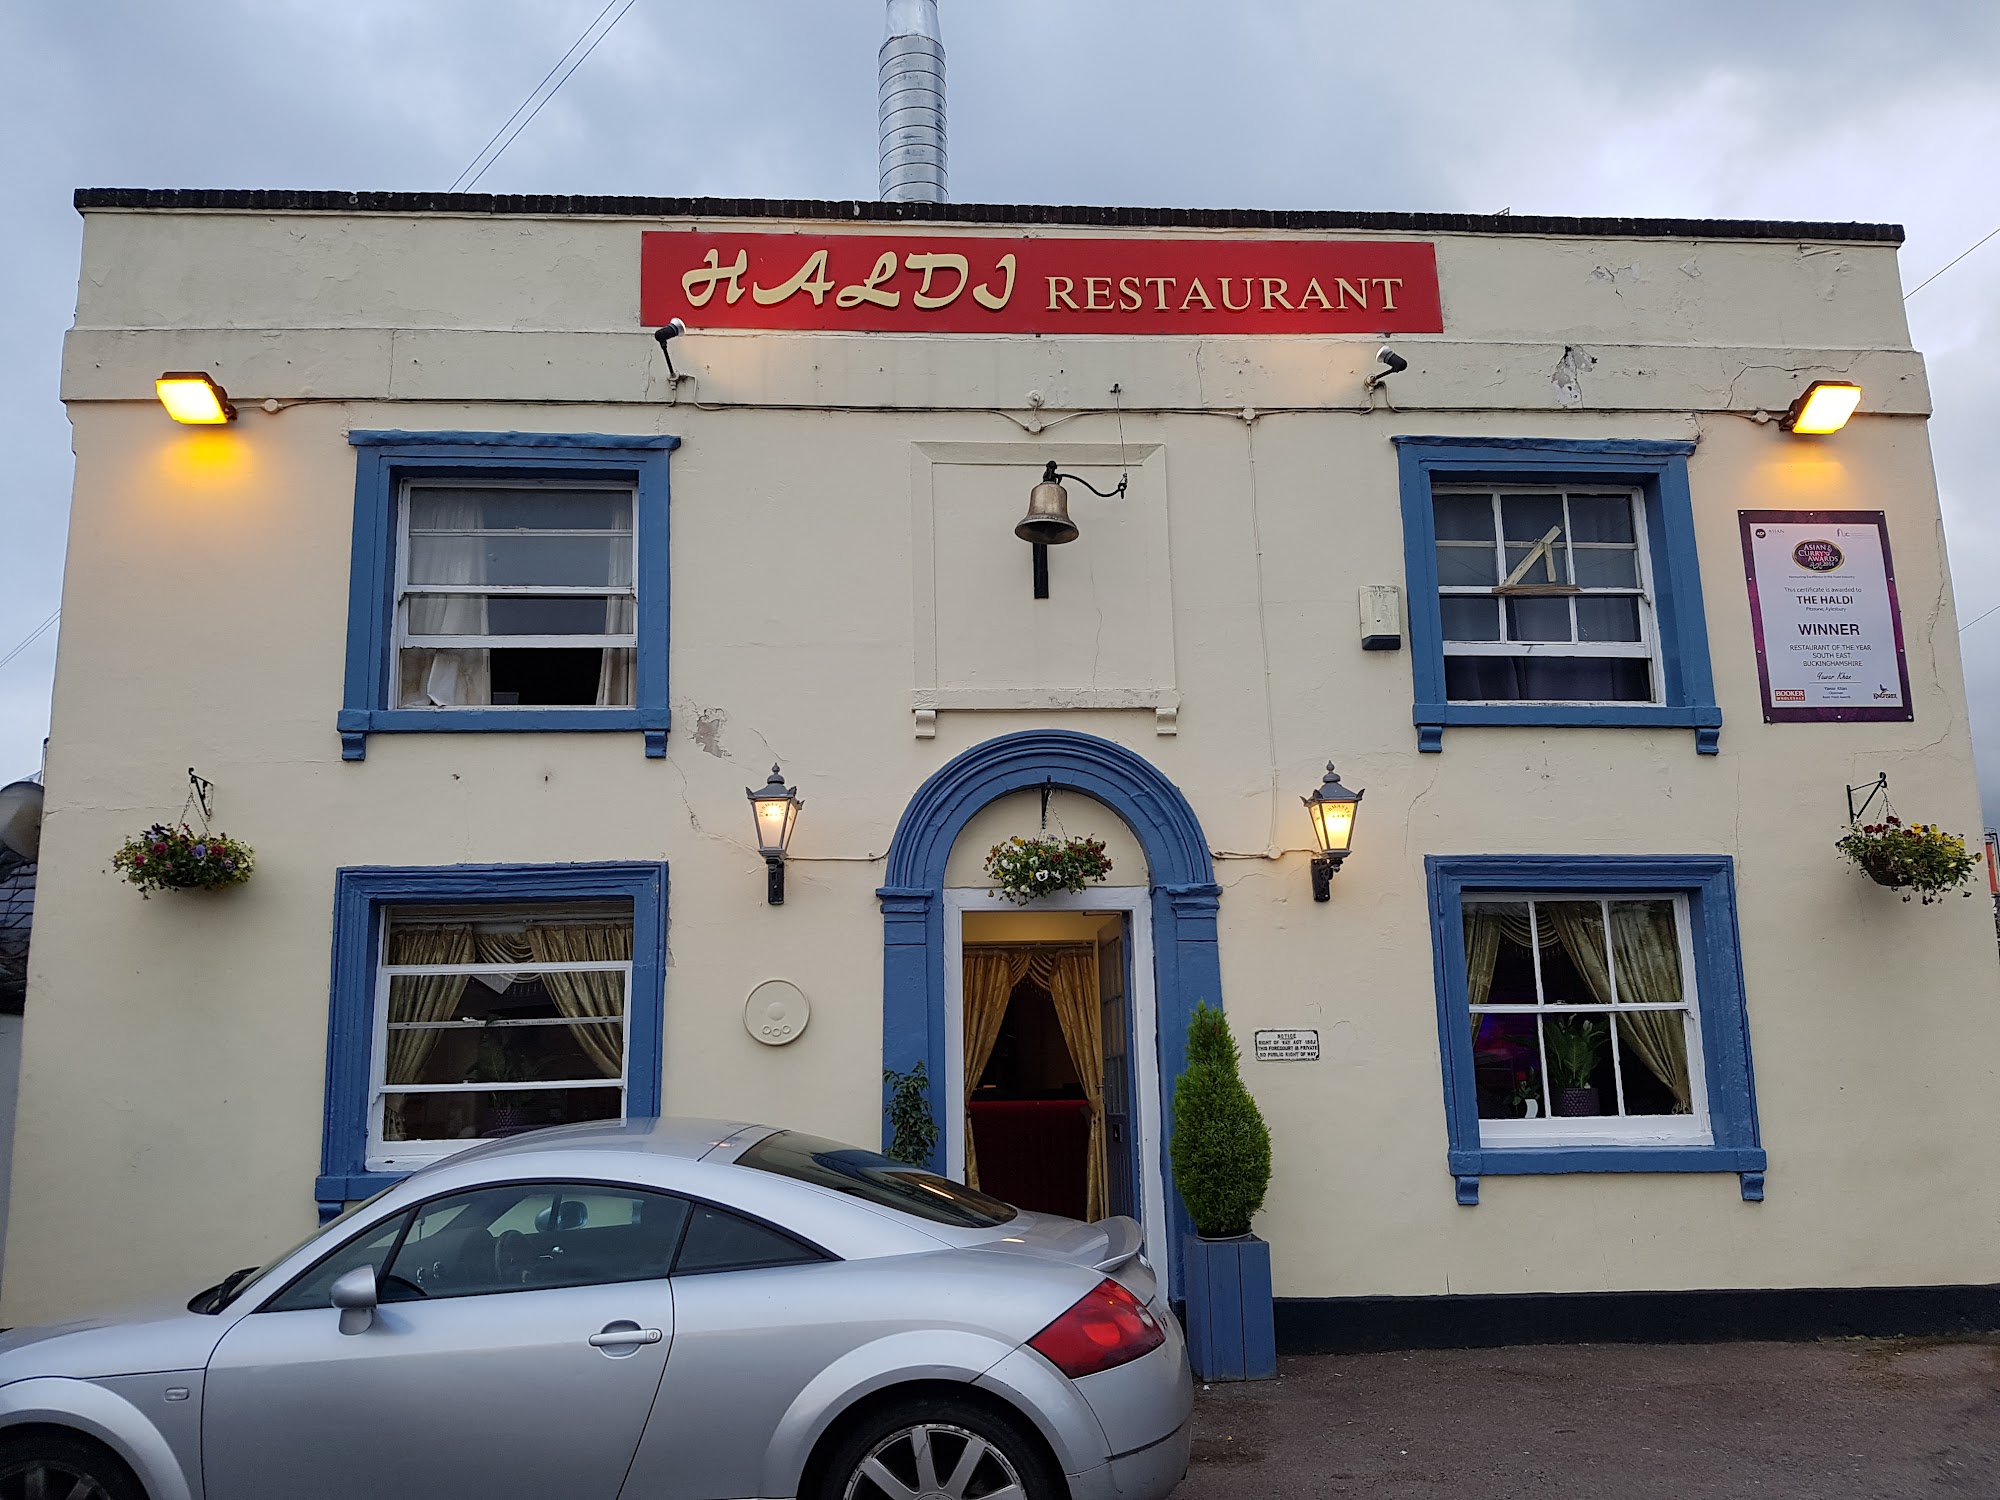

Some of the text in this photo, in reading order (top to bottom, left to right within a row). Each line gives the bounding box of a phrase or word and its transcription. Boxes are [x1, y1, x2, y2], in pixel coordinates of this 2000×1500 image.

[681, 248, 1403, 312] HALDI RESTAURANT
[1796, 596, 1853, 604] THE HALDI
[1798, 624, 1860, 635] WINNER
